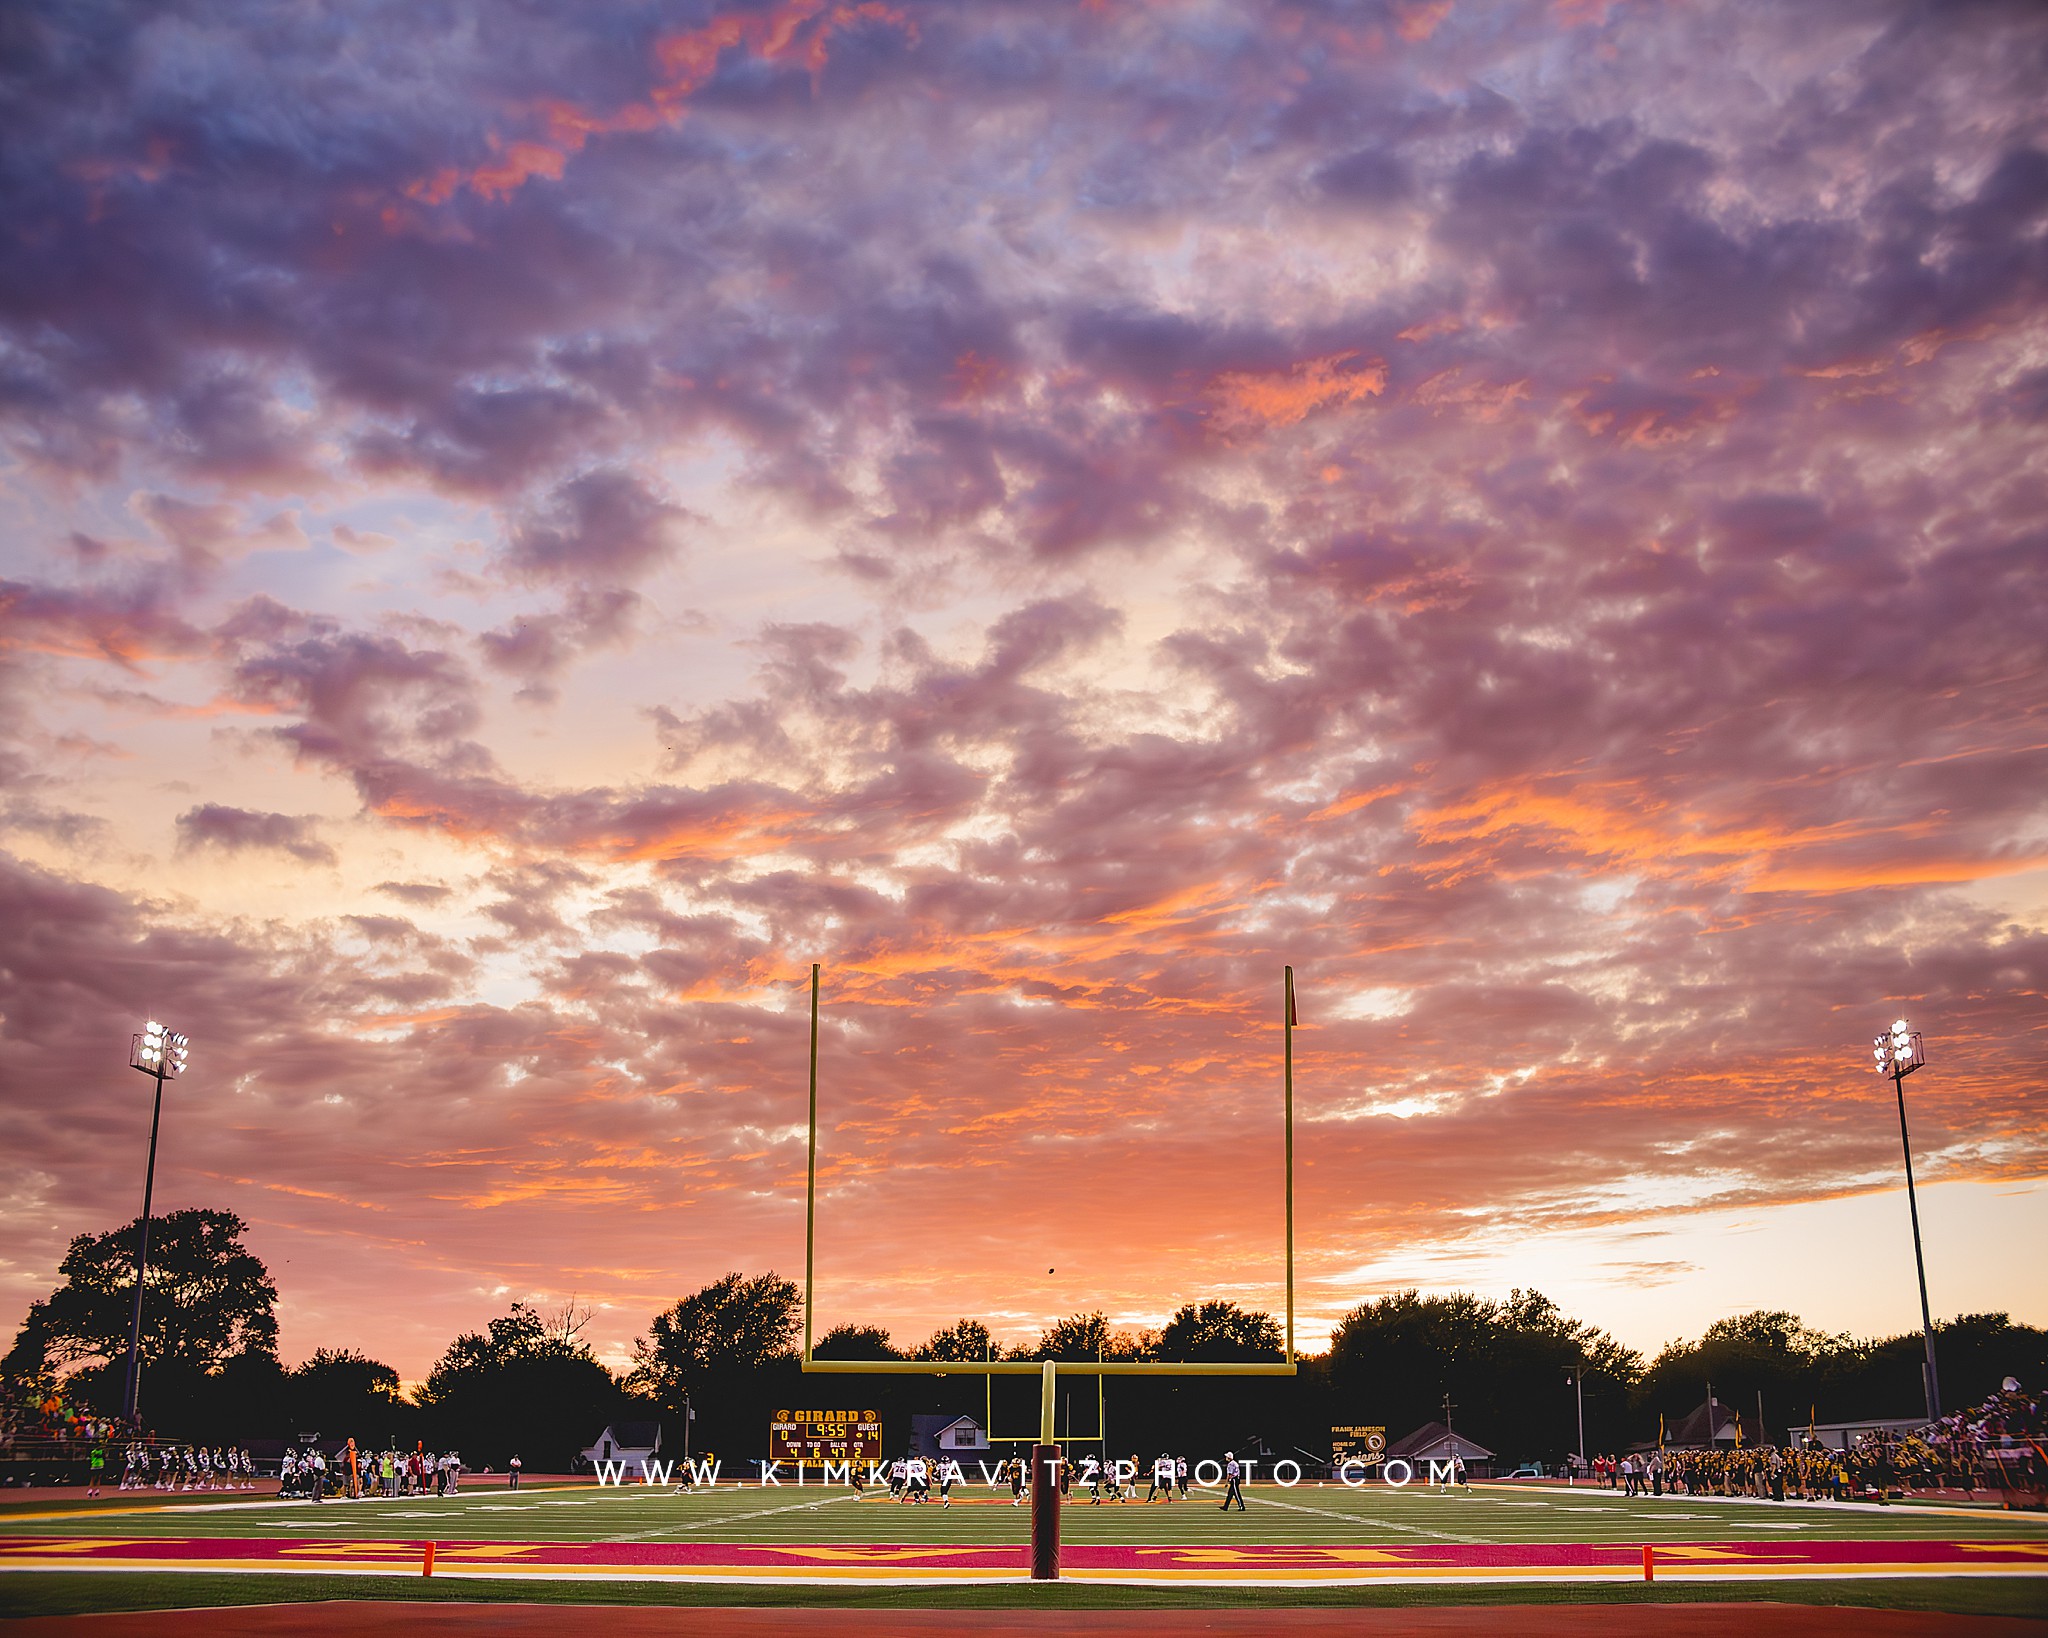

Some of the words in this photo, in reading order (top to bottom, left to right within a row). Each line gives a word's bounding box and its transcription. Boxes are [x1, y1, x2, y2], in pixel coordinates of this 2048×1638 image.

[795, 1410, 859, 1422] GIRARD
[817, 1424, 845, 1436] 9:55
[781, 1430, 788, 1441] 0
[867, 1431, 879, 1441] 14
[790, 1448, 798, 1458] 4
[813, 1448, 821, 1458] 6
[831, 1448, 846, 1458] 47
[854, 1448, 862, 1458] 2
[1332, 1451, 1385, 1466] Trojans
